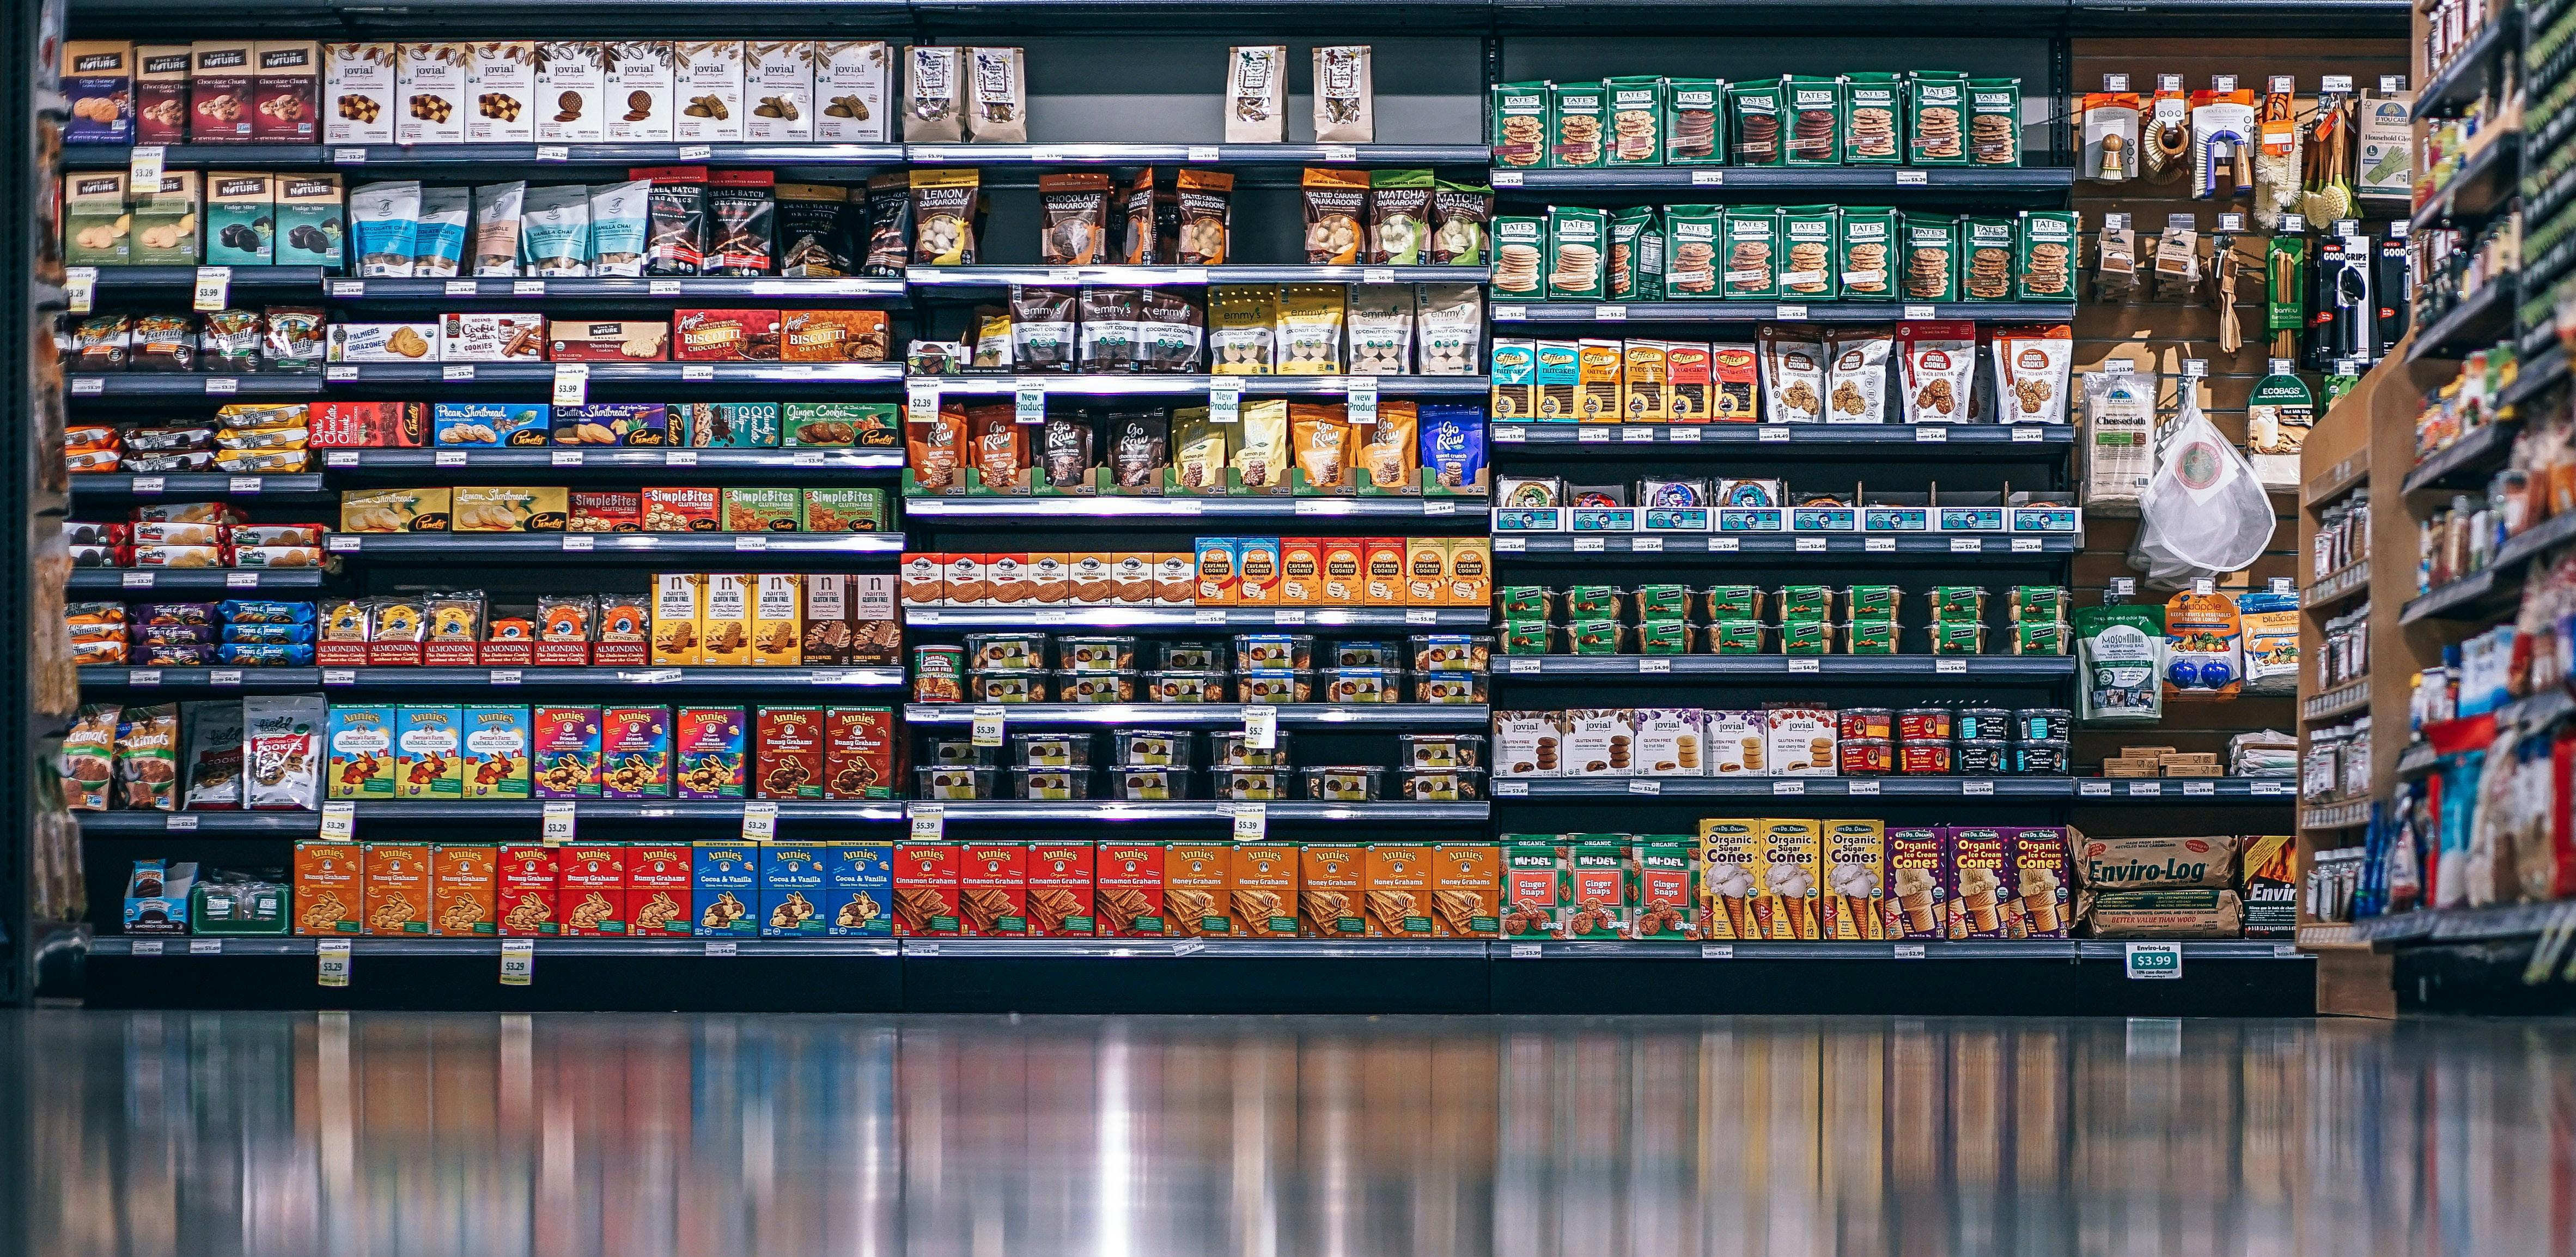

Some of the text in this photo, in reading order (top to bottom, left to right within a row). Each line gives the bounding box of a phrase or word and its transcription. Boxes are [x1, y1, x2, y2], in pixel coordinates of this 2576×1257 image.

[205, 56, 241, 66] NATURE
[267, 56, 303, 65] NATURE
[344, 66, 373, 77] jovial
[415, 65, 444, 77] jovial
[694, 65, 723, 76] jovial
[835, 65, 864, 76] jovial
[1508, 96, 1537, 105] TATE'S
[1567, 96, 1595, 105] TATE'S
[1800, 91, 1830, 99] TATE'S
[135, 168, 153, 178] $3.29
[290, 184, 327, 195] NATURE
[923, 190, 962, 199] LEMON
[1378, 190, 1425, 199] MATCHA
[919, 198, 967, 207] SNAKAROONS
[1046, 194, 1100, 203] CHOCOLATE
[1504, 222, 1534, 231] TATE'S
[2324, 252, 2366, 262] GOOD GRIPS
[199, 288, 217, 296] $3.99
[1094, 302, 1131, 315] emmy's
[1153, 306, 1190, 317] emmy's
[1290, 306, 1328, 318] emmy's
[350, 328, 379, 340] PALMIERS
[462, 325, 495, 335] Cookie
[469, 333, 497, 342] Butter
[790, 329, 845, 345] BISCOTTI
[799, 343, 835, 352] ORANGE
[559, 385, 576, 393] $3.99
[1021, 392, 1038, 401] New
[912, 398, 931, 408] $2.39
[1016, 402, 1044, 411] Product
[439, 405, 506, 418] Pecan Shortbread
[557, 405, 630, 417] Butter Shortbread
[787, 405, 815, 420] Ginger
[990, 421, 1005, 433] Go
[2097, 417, 2145, 426] Cheesecloth
[1444, 422, 1458, 435] Go
[984, 433, 1010, 450] Raw
[1436, 435, 1464, 451] Raw
[455, 489, 531, 501] Lemon Shortbread
[651, 490, 714, 502] SimpleBites
[732, 490, 793, 502] SimpleBites
[411, 713, 448, 724] Annie's
[552, 713, 585, 722] Annie's
[774, 713, 806, 724] Annie's
[977, 725, 995, 734] $5.39
[1586, 721, 1611, 732] jovial
[1789, 721, 1814, 731] jovial
[548, 824, 567, 833] $3.29
[1709, 835, 1752, 845] Organic
[1895, 840, 1936, 851] Organic
[1719, 845, 1741, 853] Sugar
[576, 849, 611, 861] Annie's
[777, 849, 811, 861] Annie's
[910, 849, 944, 861] Annie's
[1181, 849, 1215, 861] Annie's
[1707, 852, 1753, 863] Cones
[1515, 857, 1551, 866] MI-DEL
[1893, 857, 1937, 869] Cones
[2090, 859, 2206, 882] Enviro-Log
[1520, 881, 1546, 890] Ginger
[1521, 888, 1545, 897] Snaps
[2252, 884, 2296, 901] Envir
[506, 962, 524, 971] $3.29
[2137, 956, 2171, 967] $3.99
